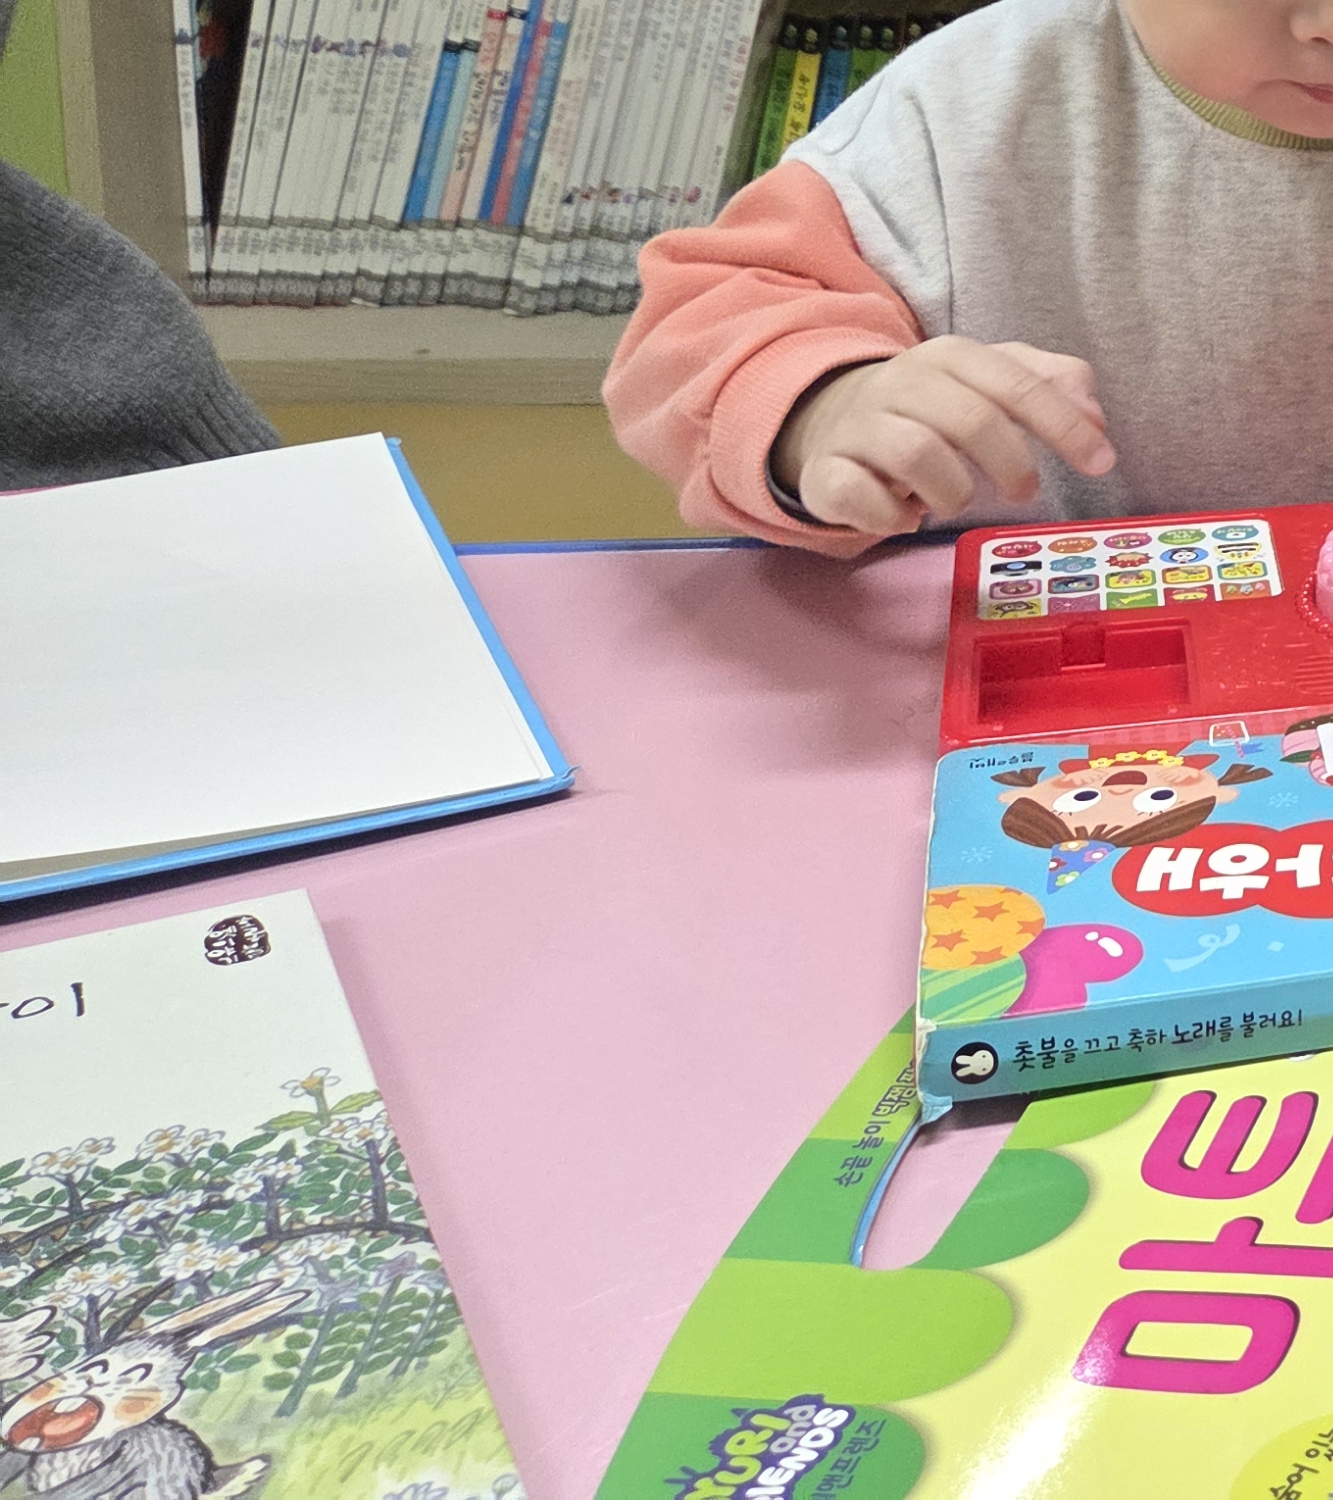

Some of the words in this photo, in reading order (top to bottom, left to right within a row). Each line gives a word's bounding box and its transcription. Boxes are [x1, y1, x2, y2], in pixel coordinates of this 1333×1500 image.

[0, 981, 86, 1020] 이
[1011, 1034, 1077, 1069] 촛불을
[1080, 1031, 1120, 1058] 끄고
[1126, 1025, 1170, 1051] 축하
[1169, 1013, 1235, 1049] 노래를
[1238, 1007, 1306, 1041] 불러요!
[852, 1119, 892, 1151] 놀이
[833, 1155, 874, 1188] 손끝
[769, 1404, 818, 1455] and
[745, 1406, 849, 1500] IENDS
